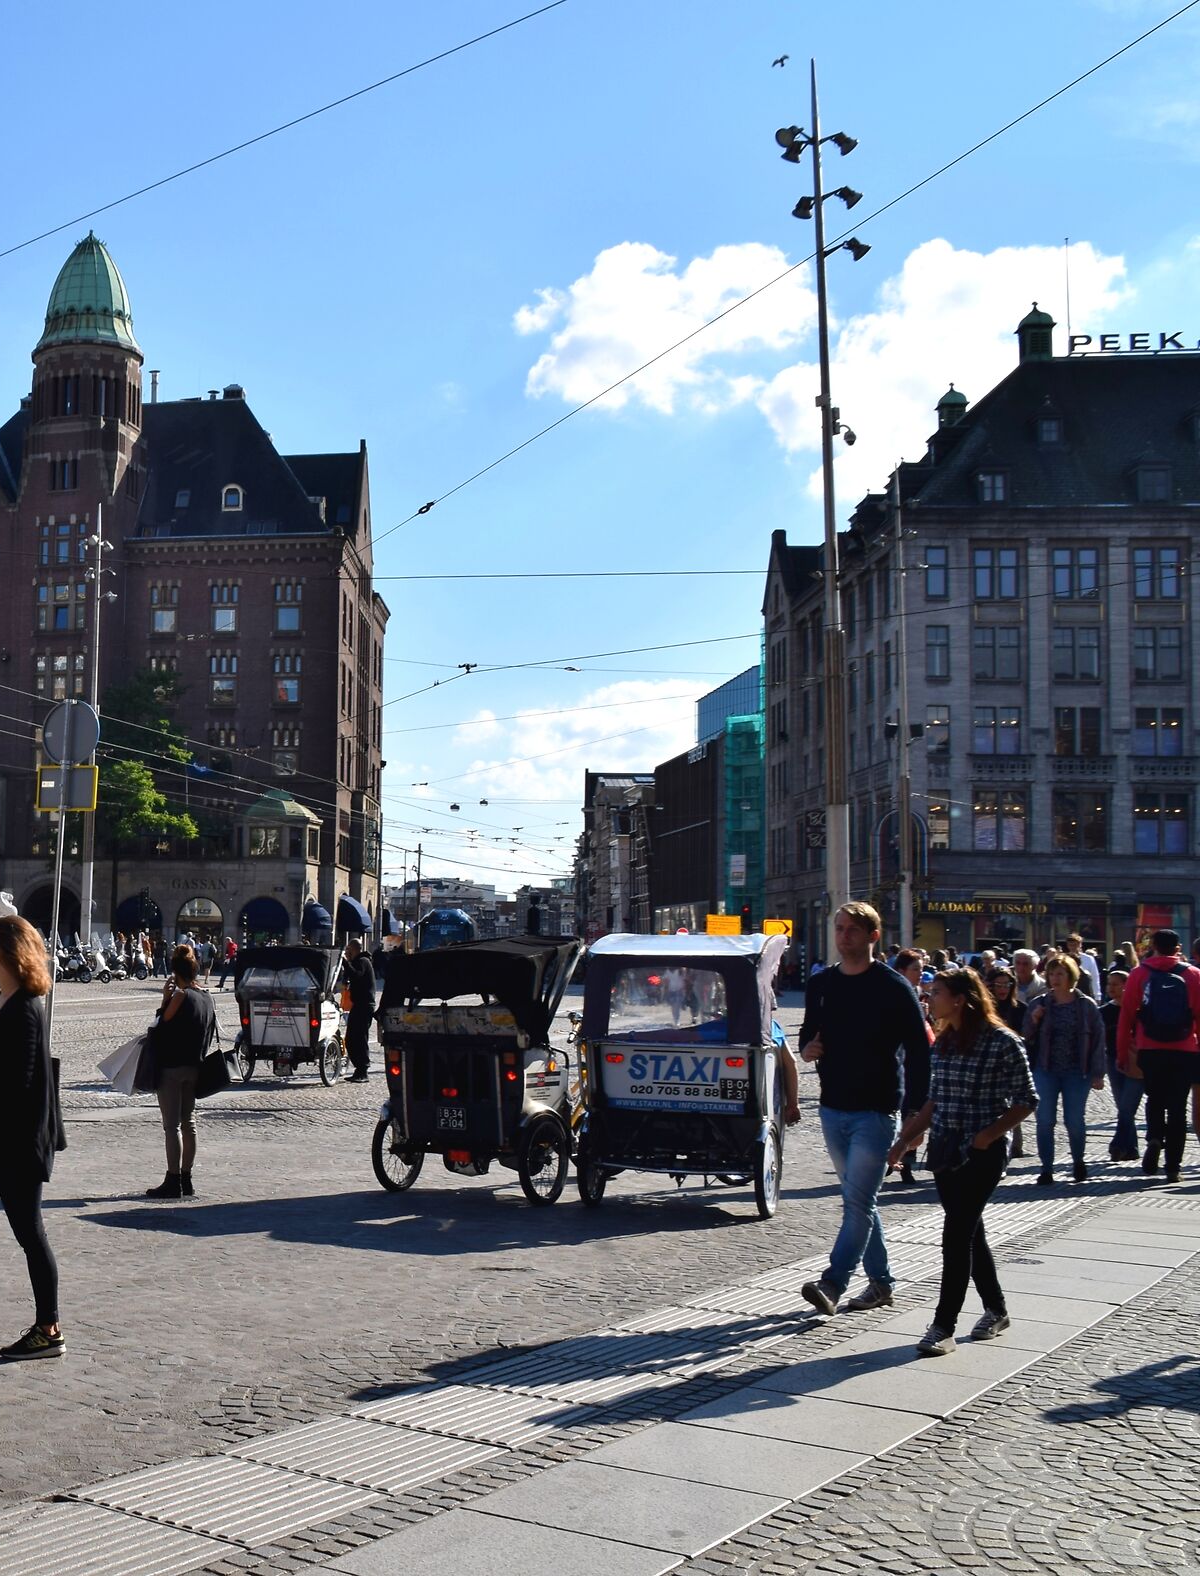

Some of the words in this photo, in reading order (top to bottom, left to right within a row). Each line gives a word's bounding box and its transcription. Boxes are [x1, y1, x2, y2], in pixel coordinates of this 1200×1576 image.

[1068, 331, 1185, 352] PEEK
[172, 879, 228, 889] GASSAN
[927, 902, 984, 913] MADAME
[628, 1054, 720, 1082] STAXI
[630, 1085, 653, 1095] 020
[657, 1086, 680, 1096] 705
[684, 1087, 700, 1097] 88
[703, 1088, 719, 1098] 88
[616, 1099, 672, 1108] WWW.STAXI.NL
